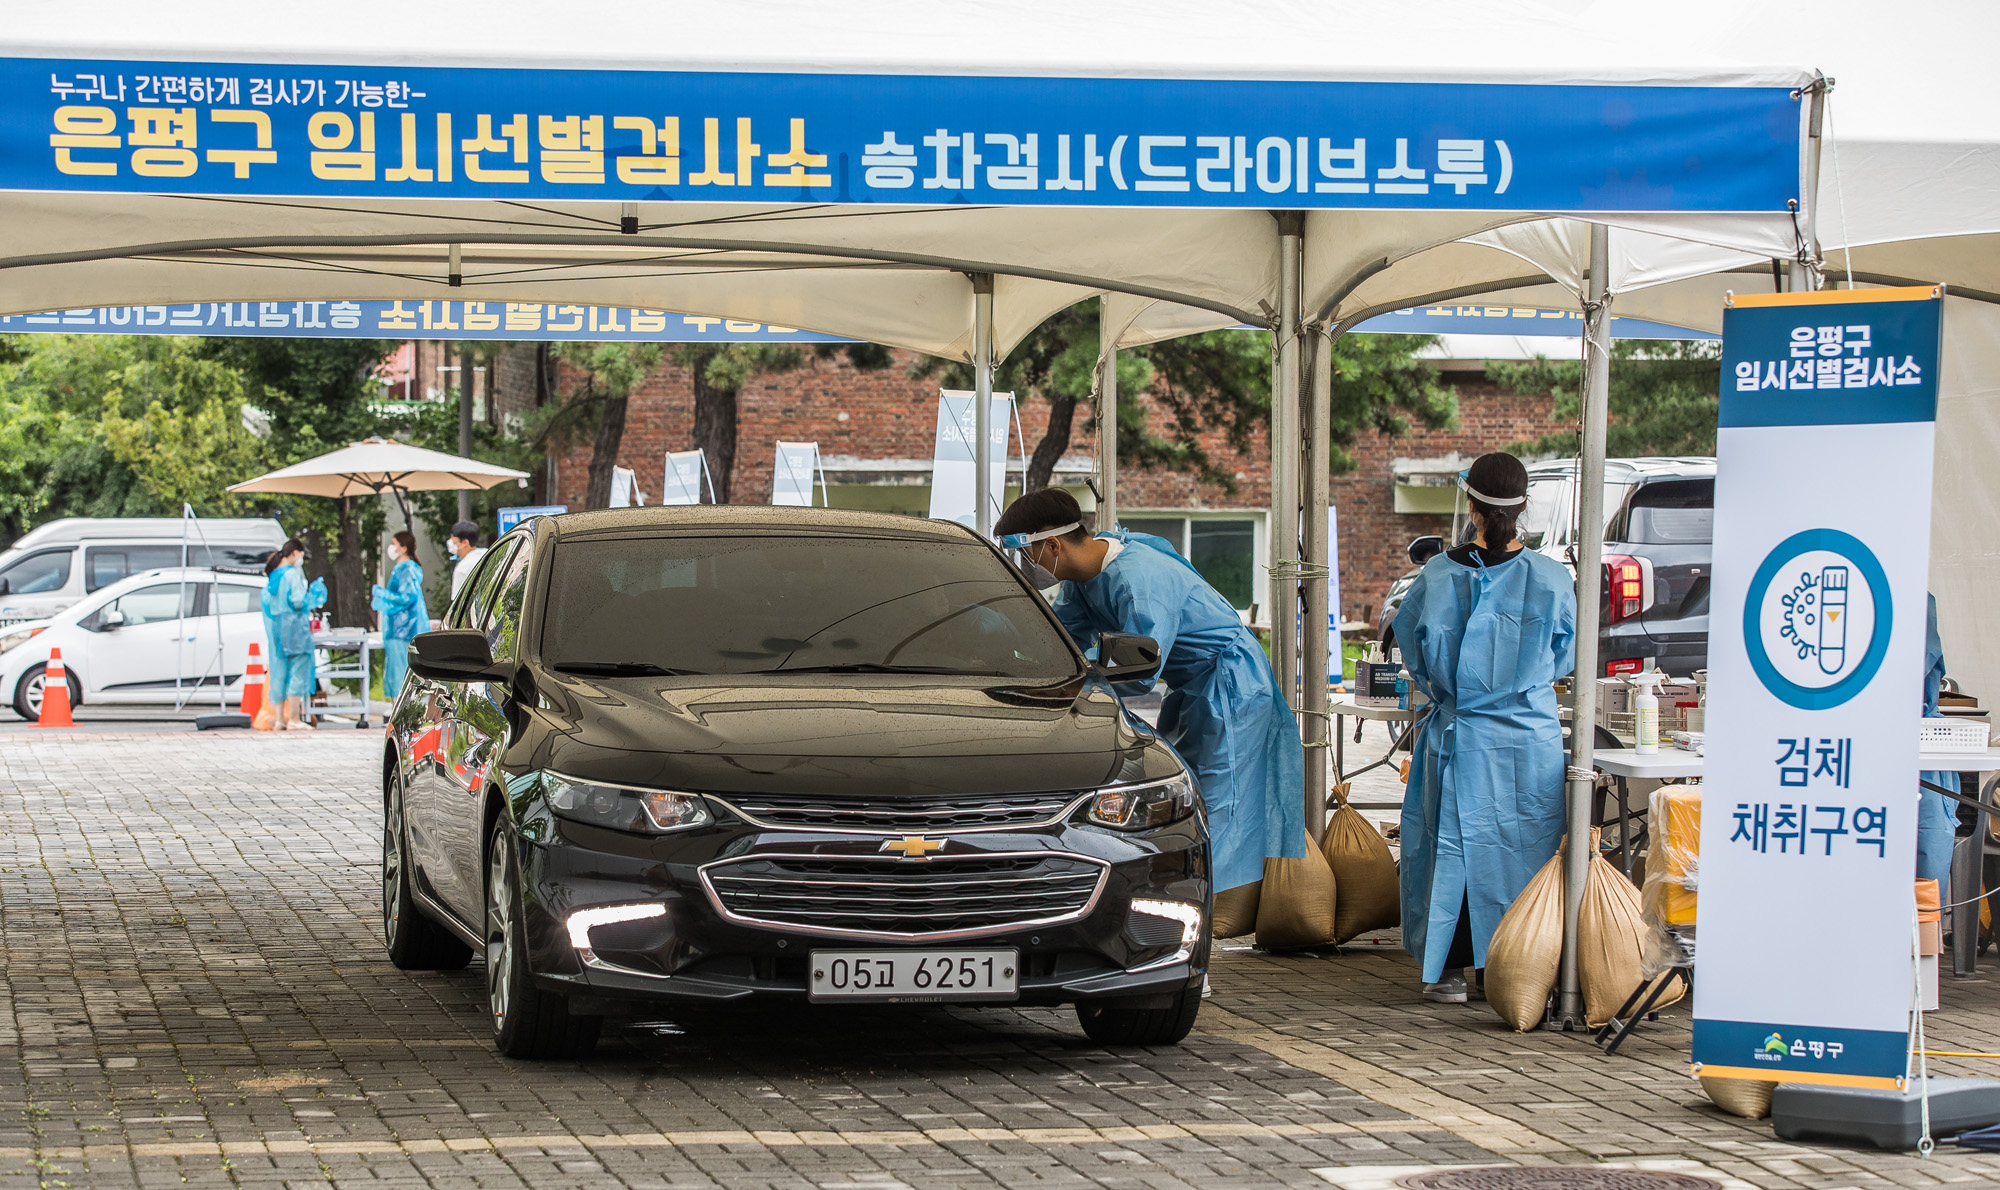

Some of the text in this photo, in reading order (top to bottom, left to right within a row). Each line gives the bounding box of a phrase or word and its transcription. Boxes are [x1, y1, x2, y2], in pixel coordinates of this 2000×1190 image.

[50, 73, 127, 103] 누구나
[135, 75, 240, 105] 간편하게
[249, 77, 326, 106] 검사가
[50, 105, 1514, 195] 은평구 임시선별검사소 승차검사(드라이브스루)
[1789, 324, 1872, 358] 은평구
[1735, 355, 1922, 392] 임시선별검사소
[1774, 737, 1851, 789] 검체
[1730, 802, 1888, 858] 채취구역
[831, 957, 994, 989] 05고 6251
[1789, 1038, 1844, 1060] 은평구
